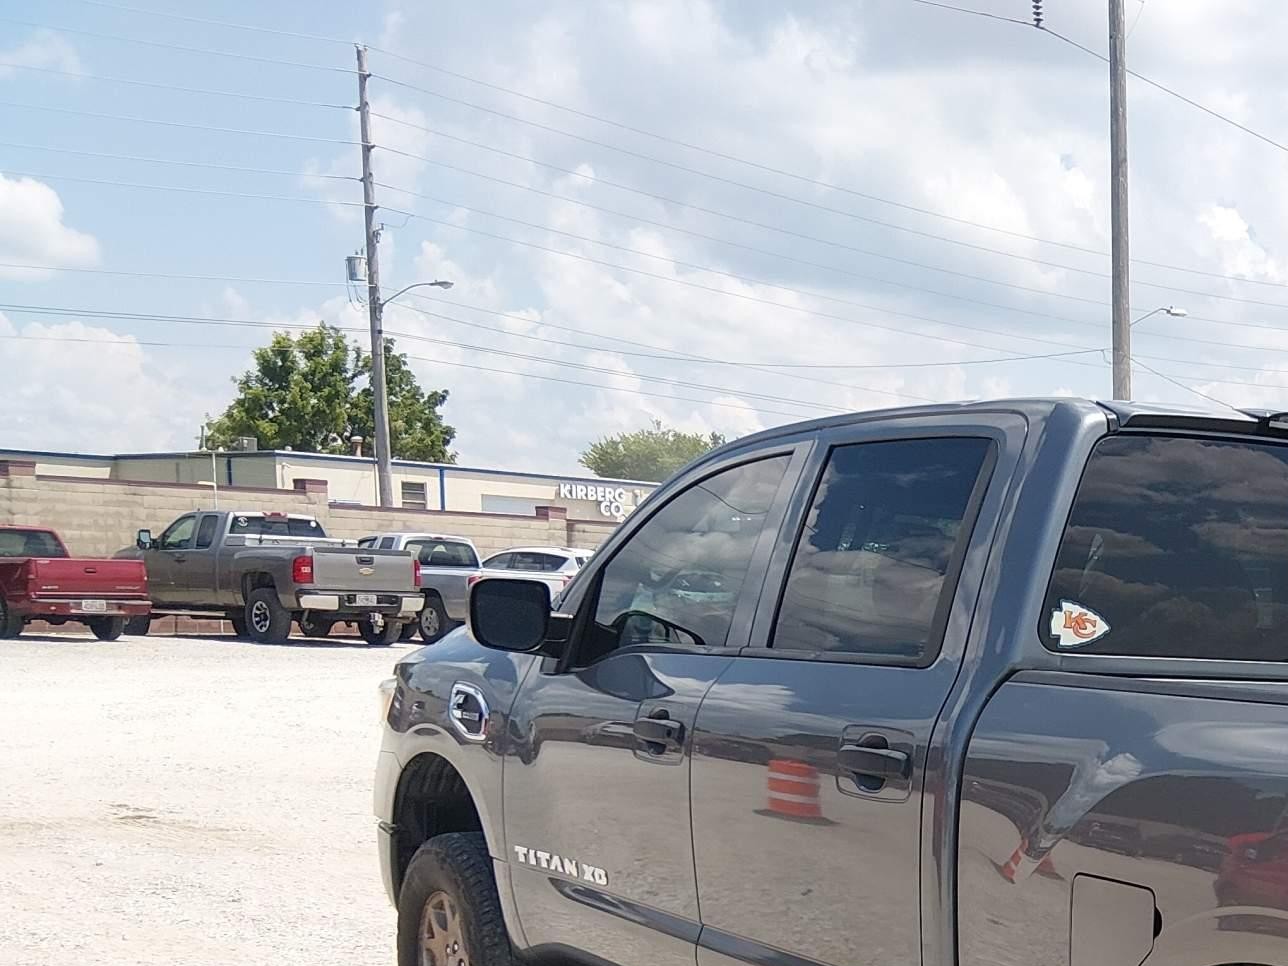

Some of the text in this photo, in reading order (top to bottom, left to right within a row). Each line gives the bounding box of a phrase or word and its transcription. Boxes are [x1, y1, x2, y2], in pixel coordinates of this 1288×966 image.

[559, 483, 625, 502] KIRBERG
[600, 501, 623, 517] CO
[514, 845, 608, 886] TITAN XD
